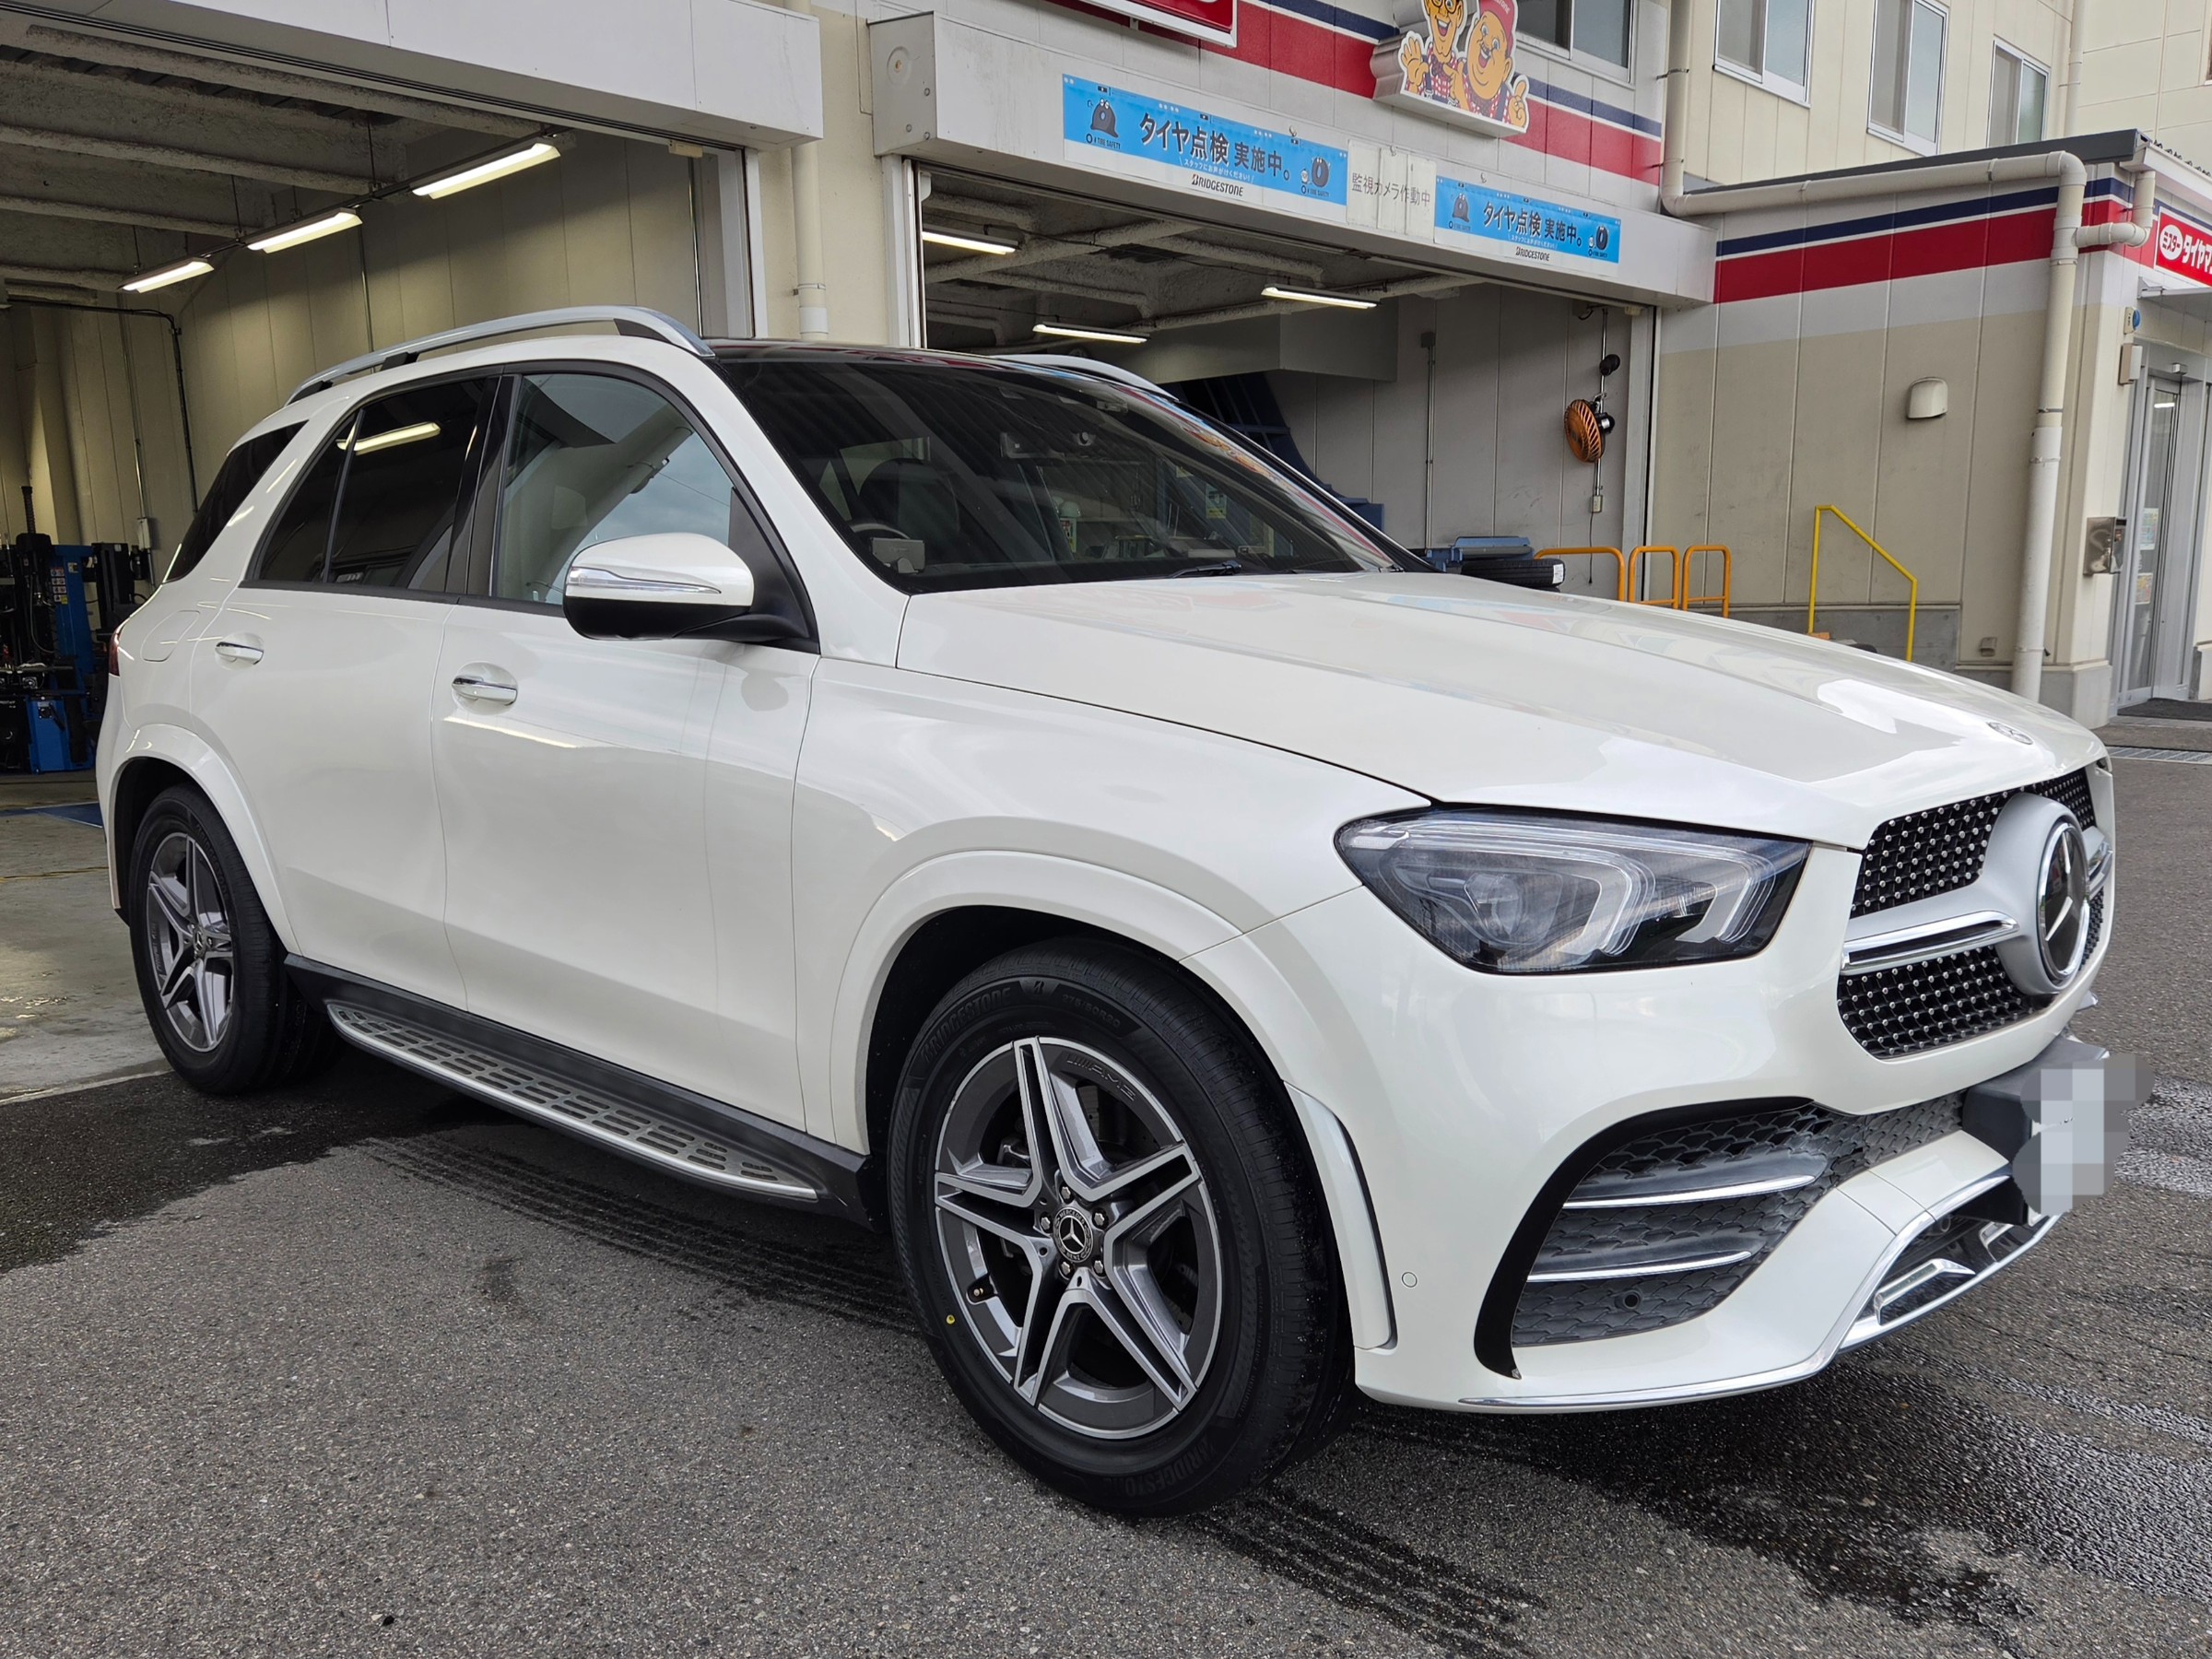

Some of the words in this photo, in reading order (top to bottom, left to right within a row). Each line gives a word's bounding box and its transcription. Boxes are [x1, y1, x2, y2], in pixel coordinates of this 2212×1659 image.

[1139, 112, 1230, 167] タイヤ点検
[1234, 141, 1291, 182] 実施中。
[1192, 173, 1244, 196] BRIDGESTONE
[1351, 171, 1431, 208] 監視カメラ作動中
[1483, 201, 1542, 238] タイヤ点検
[1545, 218, 1583, 247] 実施中。
[1515, 246, 1550, 262] BRIDGESTONE
[2162, 230, 2181, 253] ミスター
[2182, 233, 2212, 275] タイヤマ
[920, 986, 1013, 1064] BRIDGESTONE
[1061, 993, 1122, 1030] 275/50R20
